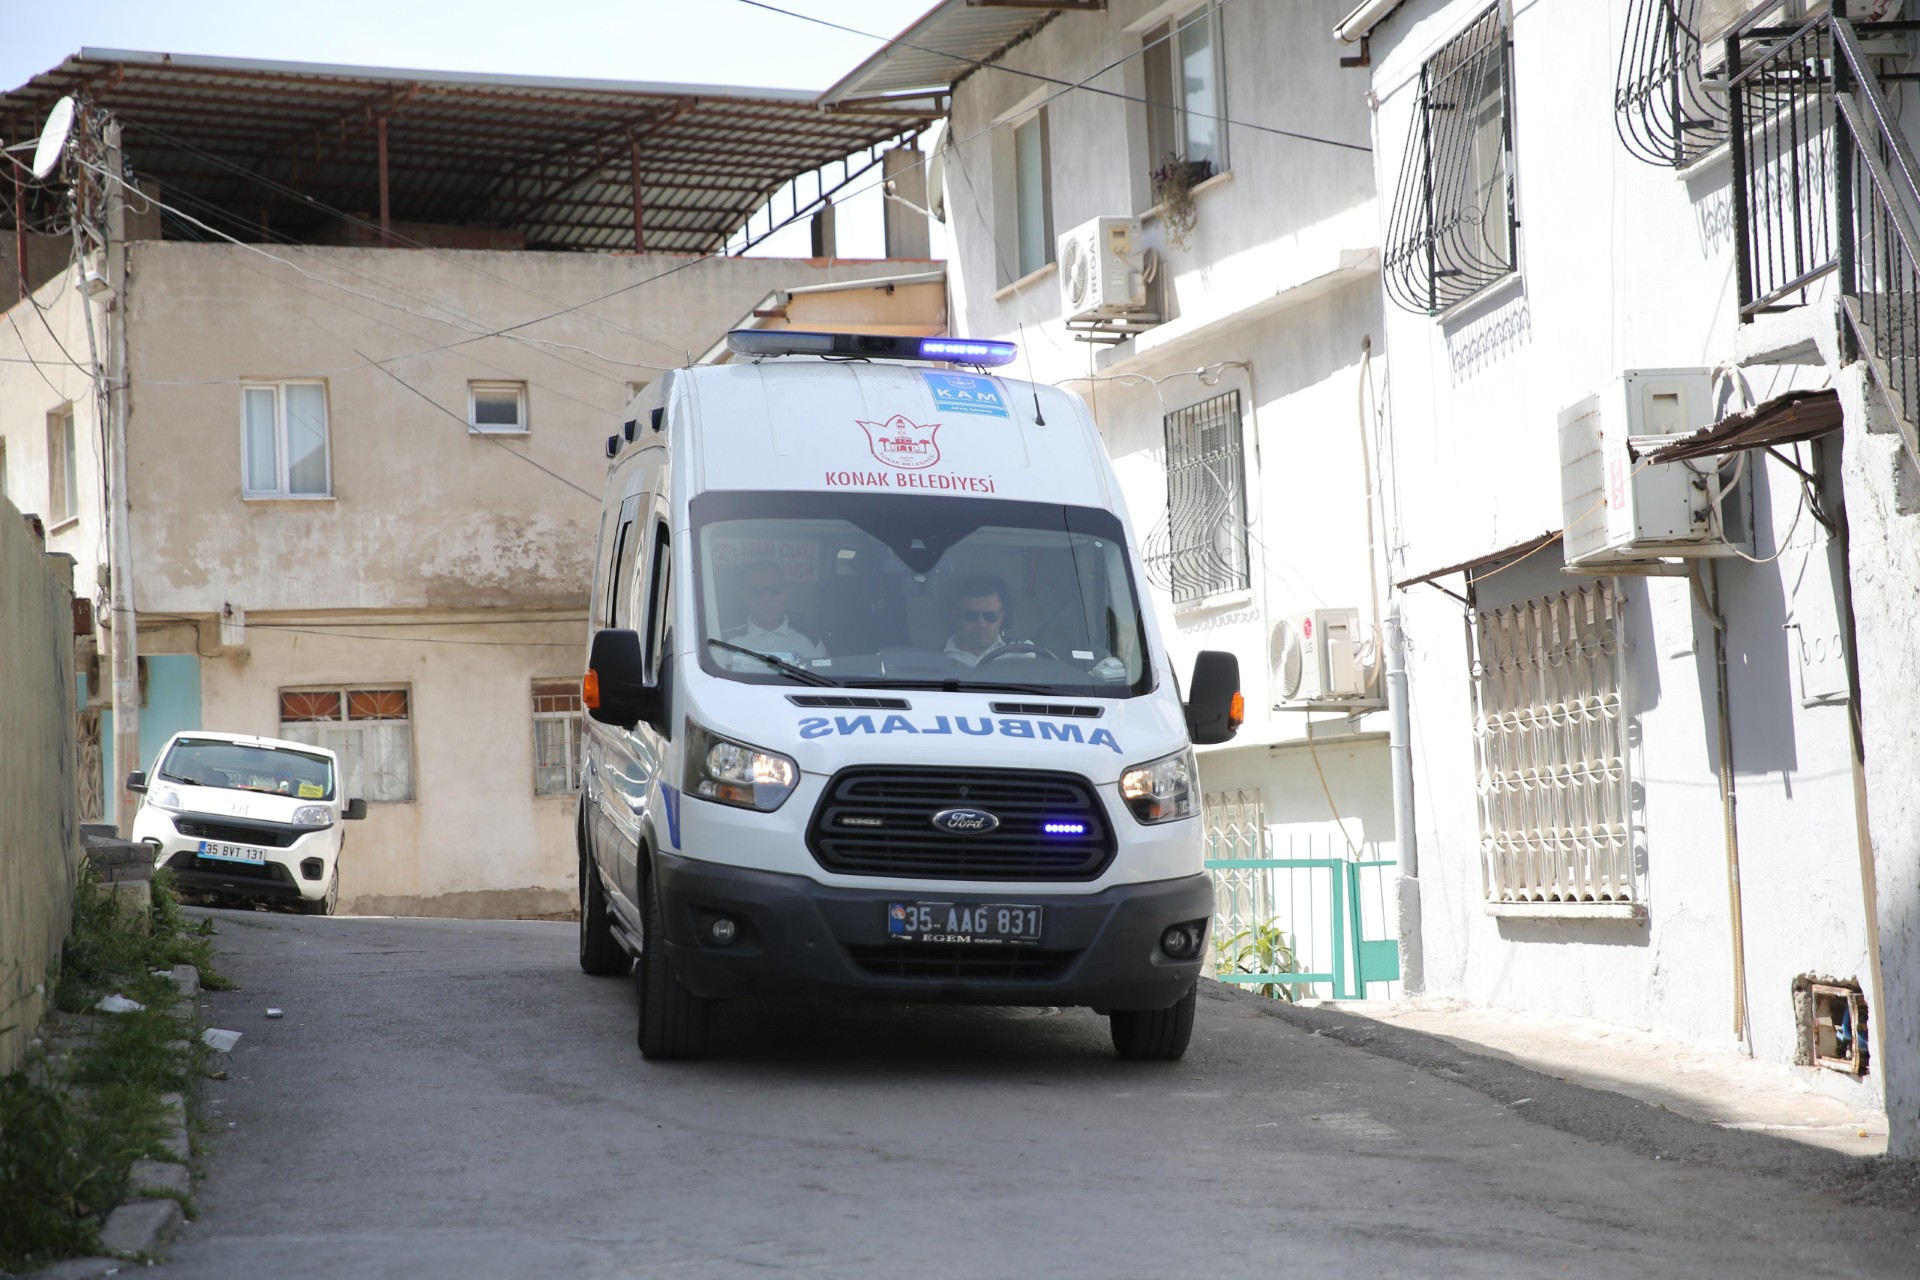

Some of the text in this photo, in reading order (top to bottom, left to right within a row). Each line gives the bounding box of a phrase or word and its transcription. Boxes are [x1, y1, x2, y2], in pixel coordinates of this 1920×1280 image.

[1089, 231, 1098, 294] REGAL
[936, 388, 997, 402] KAM
[825, 471, 996, 494] KONAK BELEDİYESİ
[1305, 642, 1313, 654] LG
[947, 812, 985, 830] Ford
[205, 843, 264, 860] 35 BVT 131
[905, 906, 1037, 935] 35 AAG 831
[922, 934, 971, 943] EGEM
